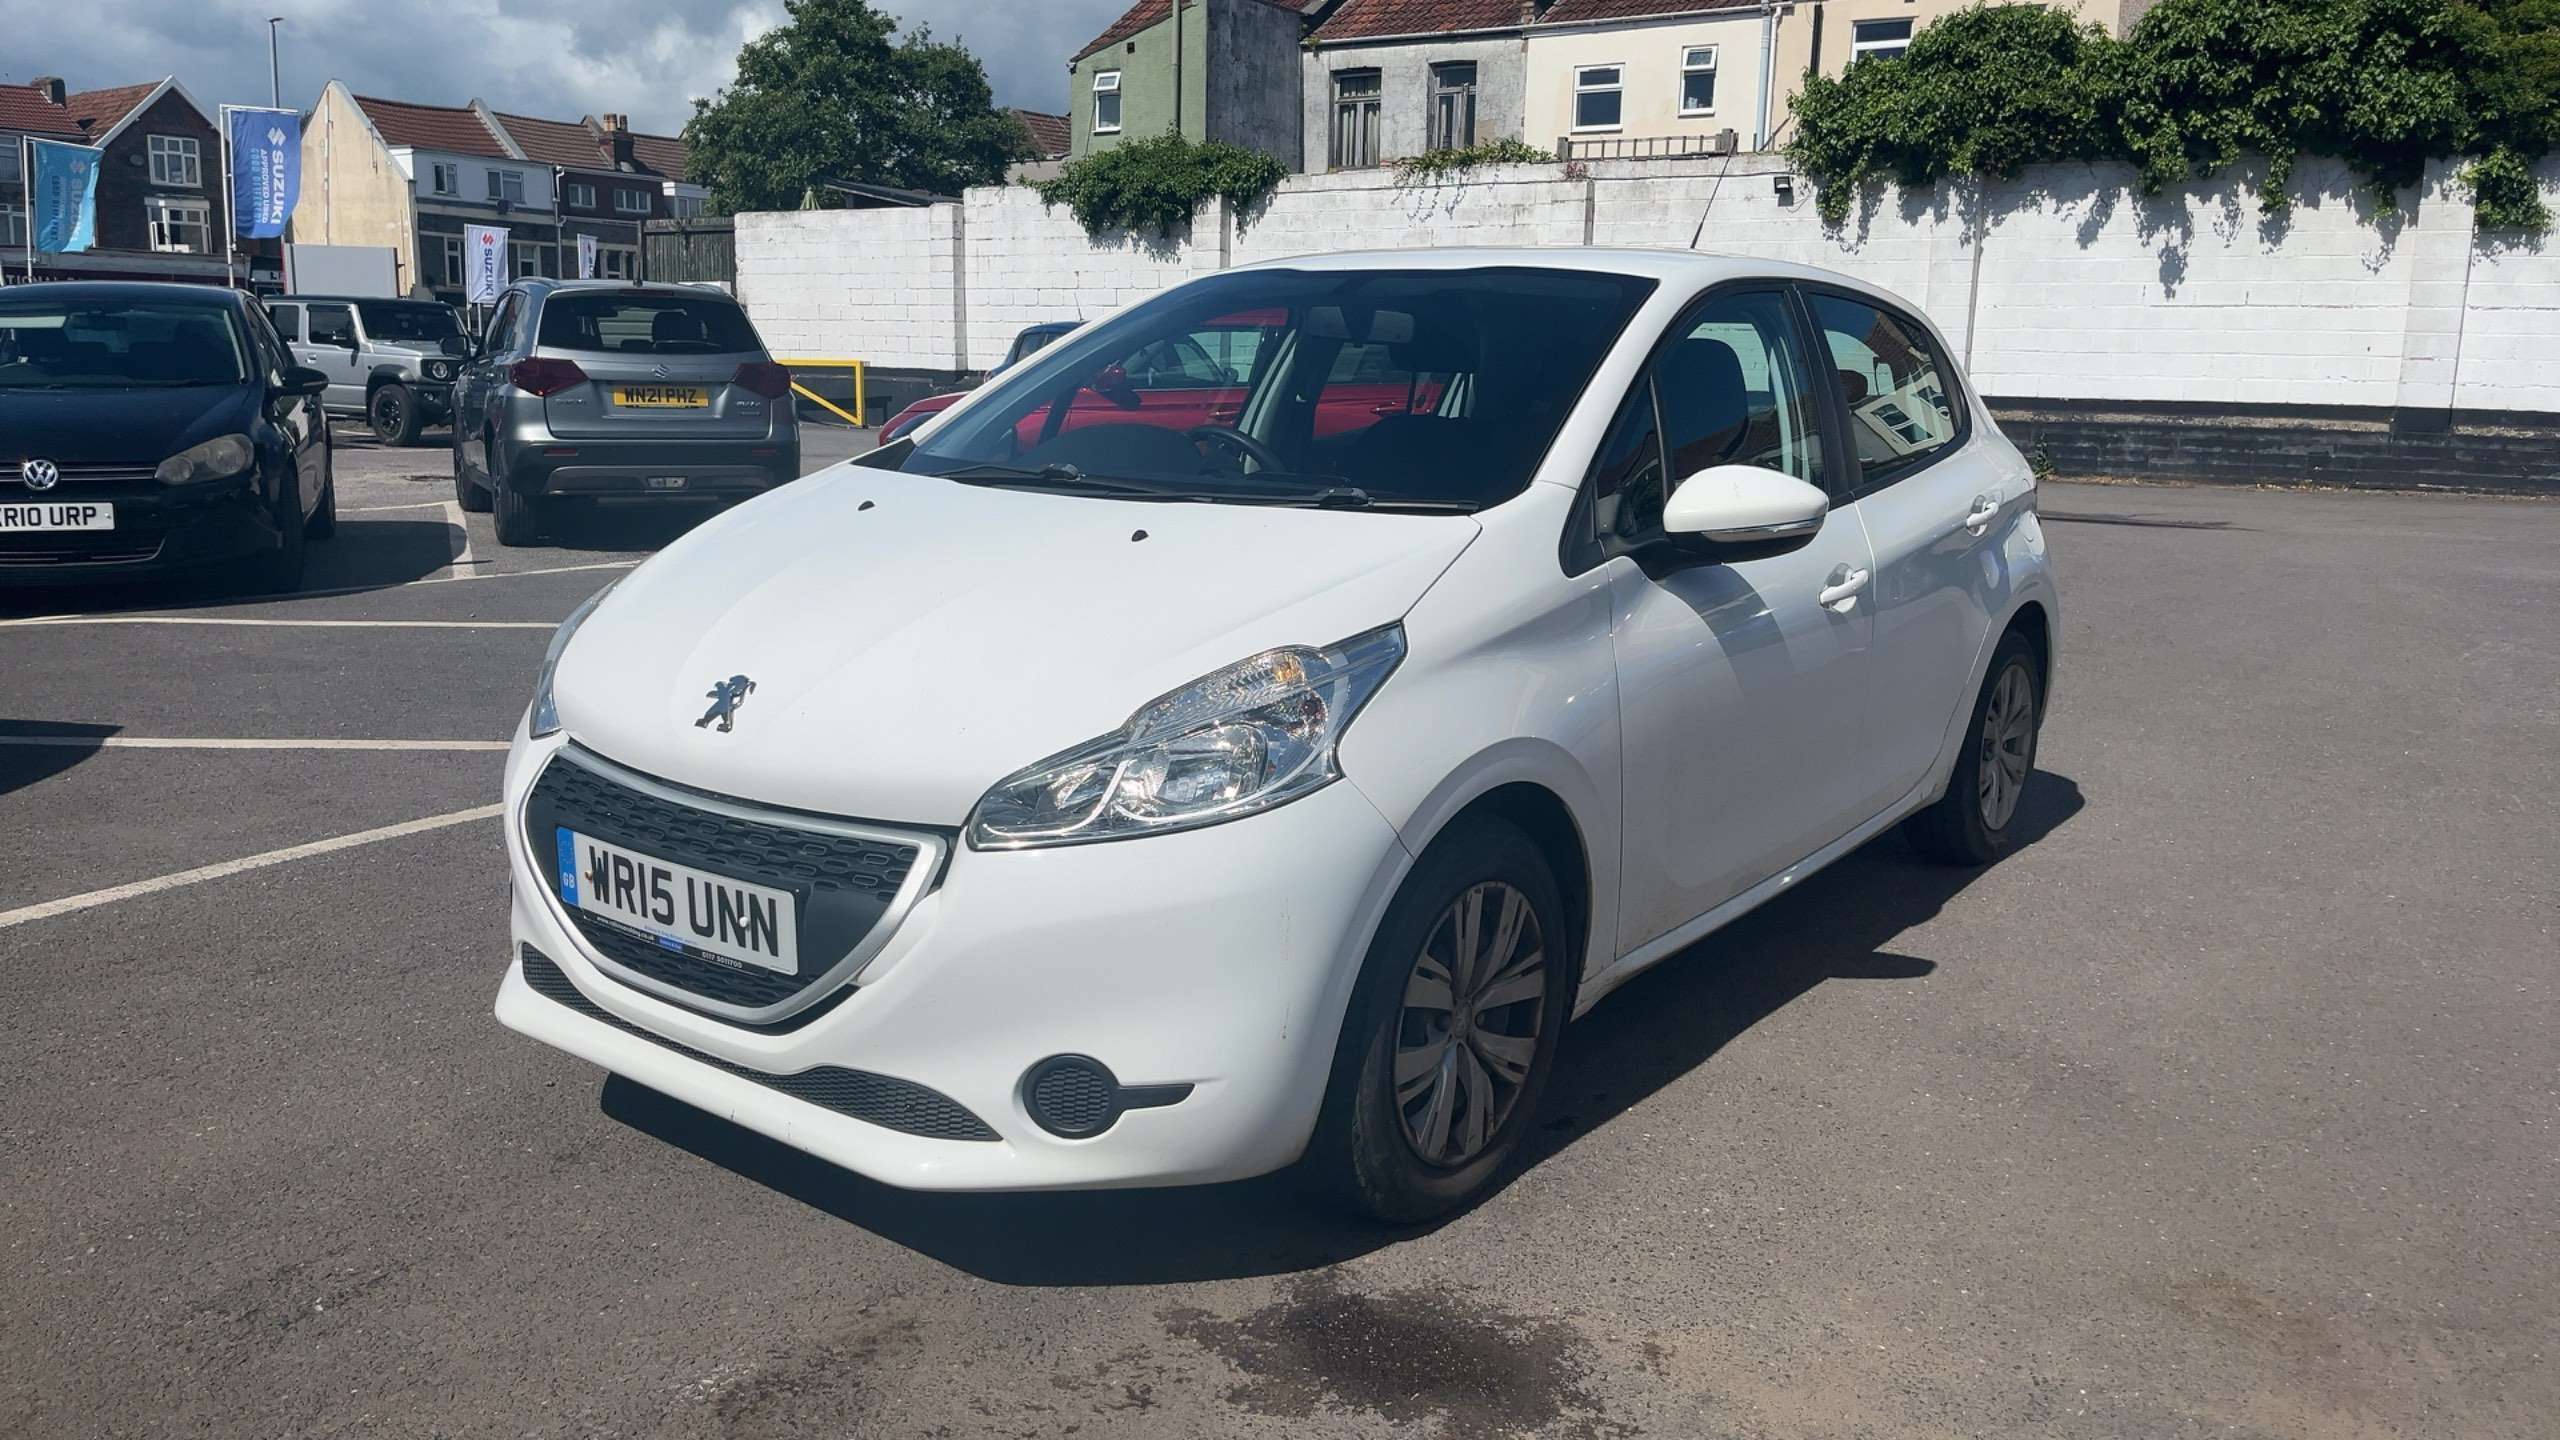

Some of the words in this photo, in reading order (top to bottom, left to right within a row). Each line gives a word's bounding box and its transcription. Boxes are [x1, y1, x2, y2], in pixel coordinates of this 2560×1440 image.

[260, 148, 270, 199] APPROVED
[270, 149, 285, 225] SUZUKI
[484, 248, 494, 296] SUZUKI
[624, 388, 664, 404] WN21
[666, 388, 699, 404] PHZ
[0, 507, 42, 528] R10
[49, 506, 97, 527] URP
[562, 872, 575, 889] GB
[588, 845, 676, 927] WR15
[686, 876, 780, 958] UNN
